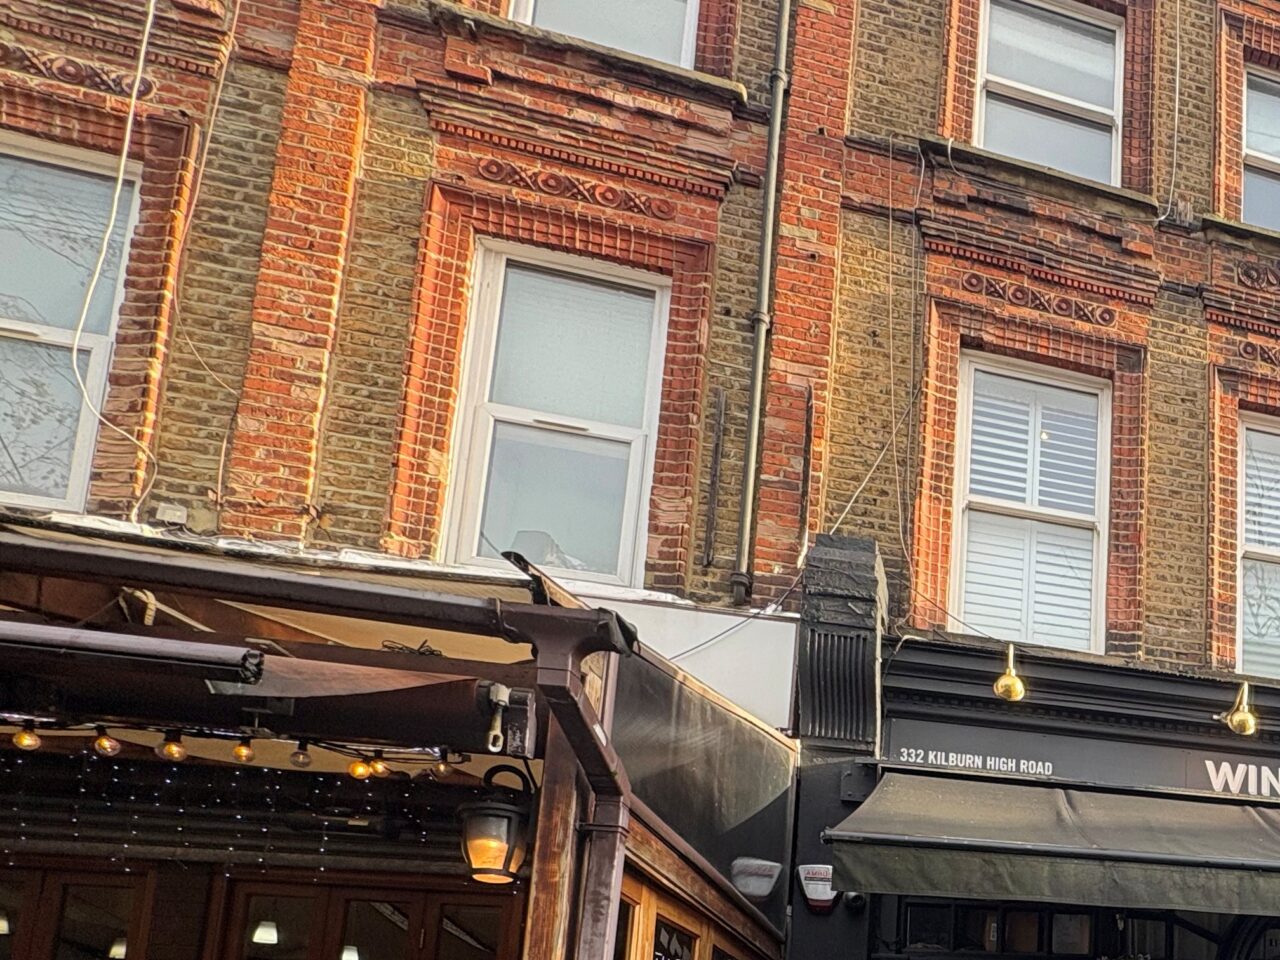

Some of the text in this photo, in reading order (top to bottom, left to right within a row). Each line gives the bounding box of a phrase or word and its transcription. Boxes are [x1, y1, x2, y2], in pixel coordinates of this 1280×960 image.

[900, 748, 1053, 776] 332 KILBURN HIGH ROAD
